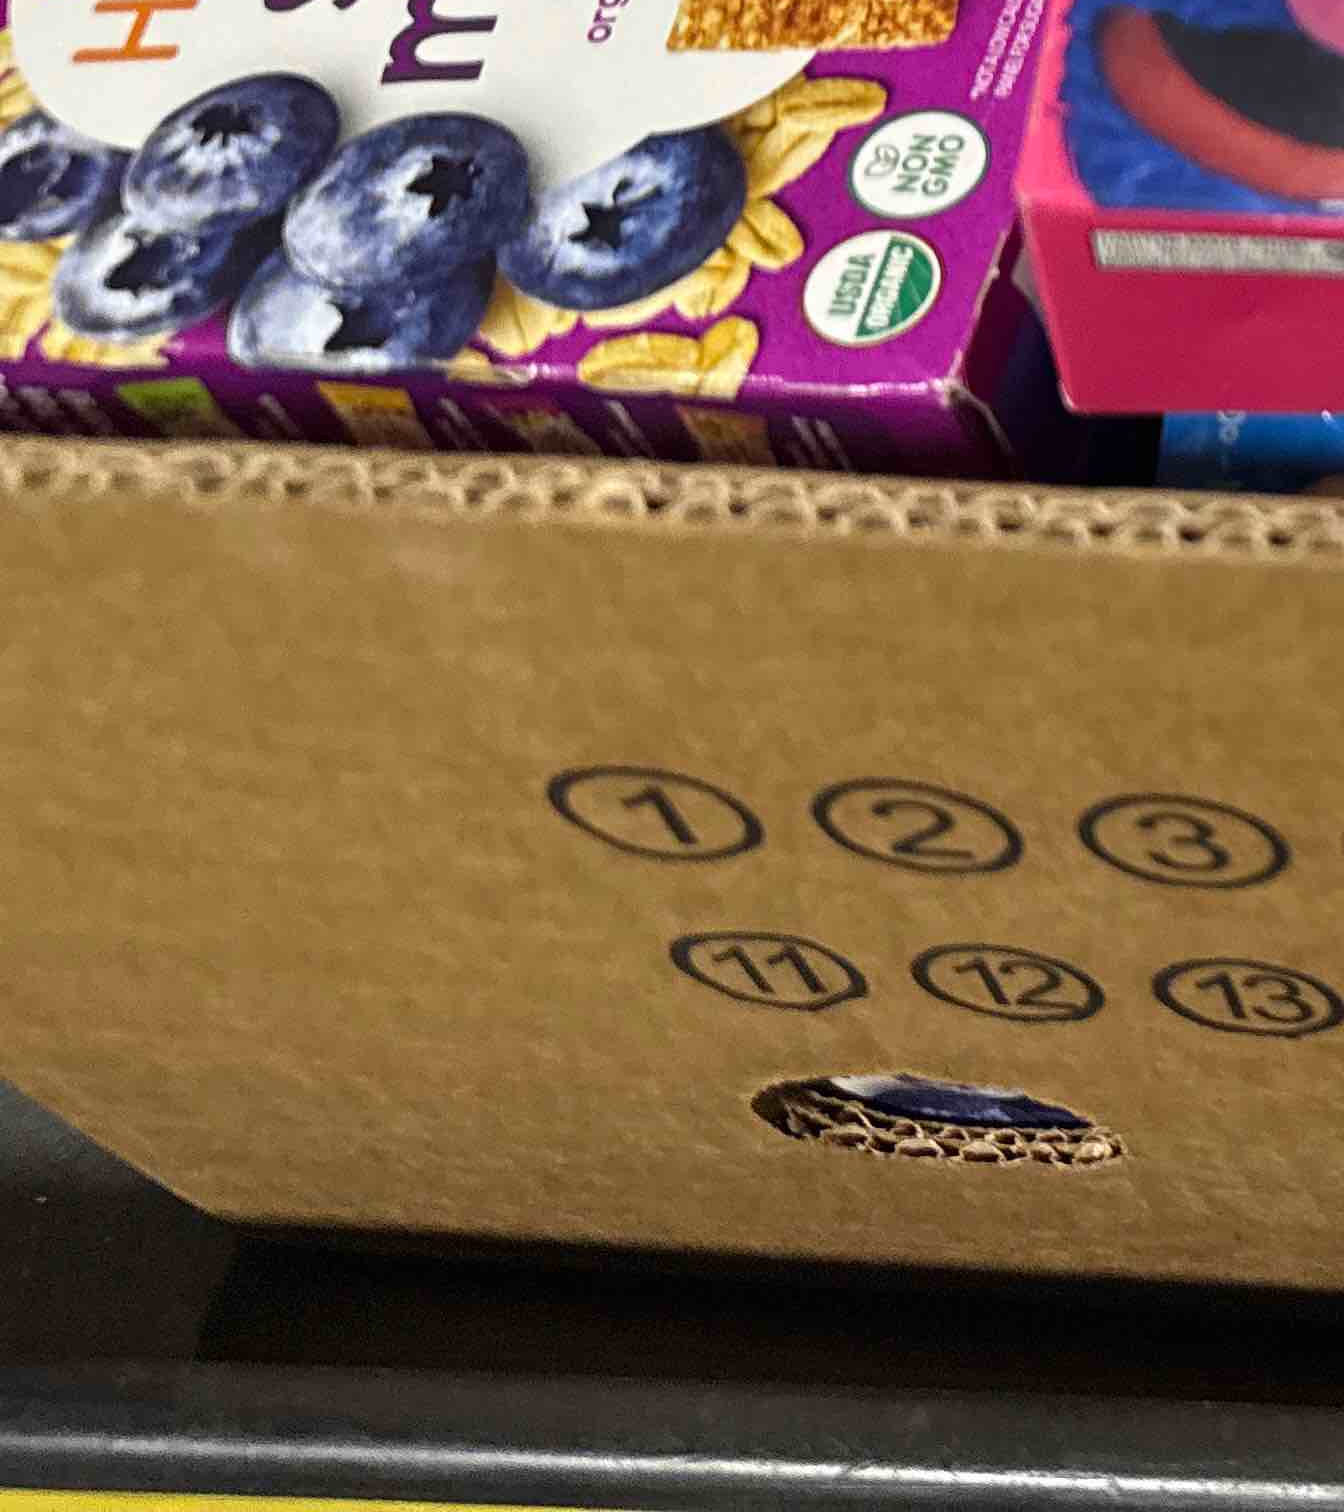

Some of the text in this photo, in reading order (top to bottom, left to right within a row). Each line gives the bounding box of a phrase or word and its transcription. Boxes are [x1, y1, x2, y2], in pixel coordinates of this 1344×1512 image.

[892, 133, 938, 194] NON
[922, 133, 966, 198] GMO
[829, 253, 876, 316] USDA
